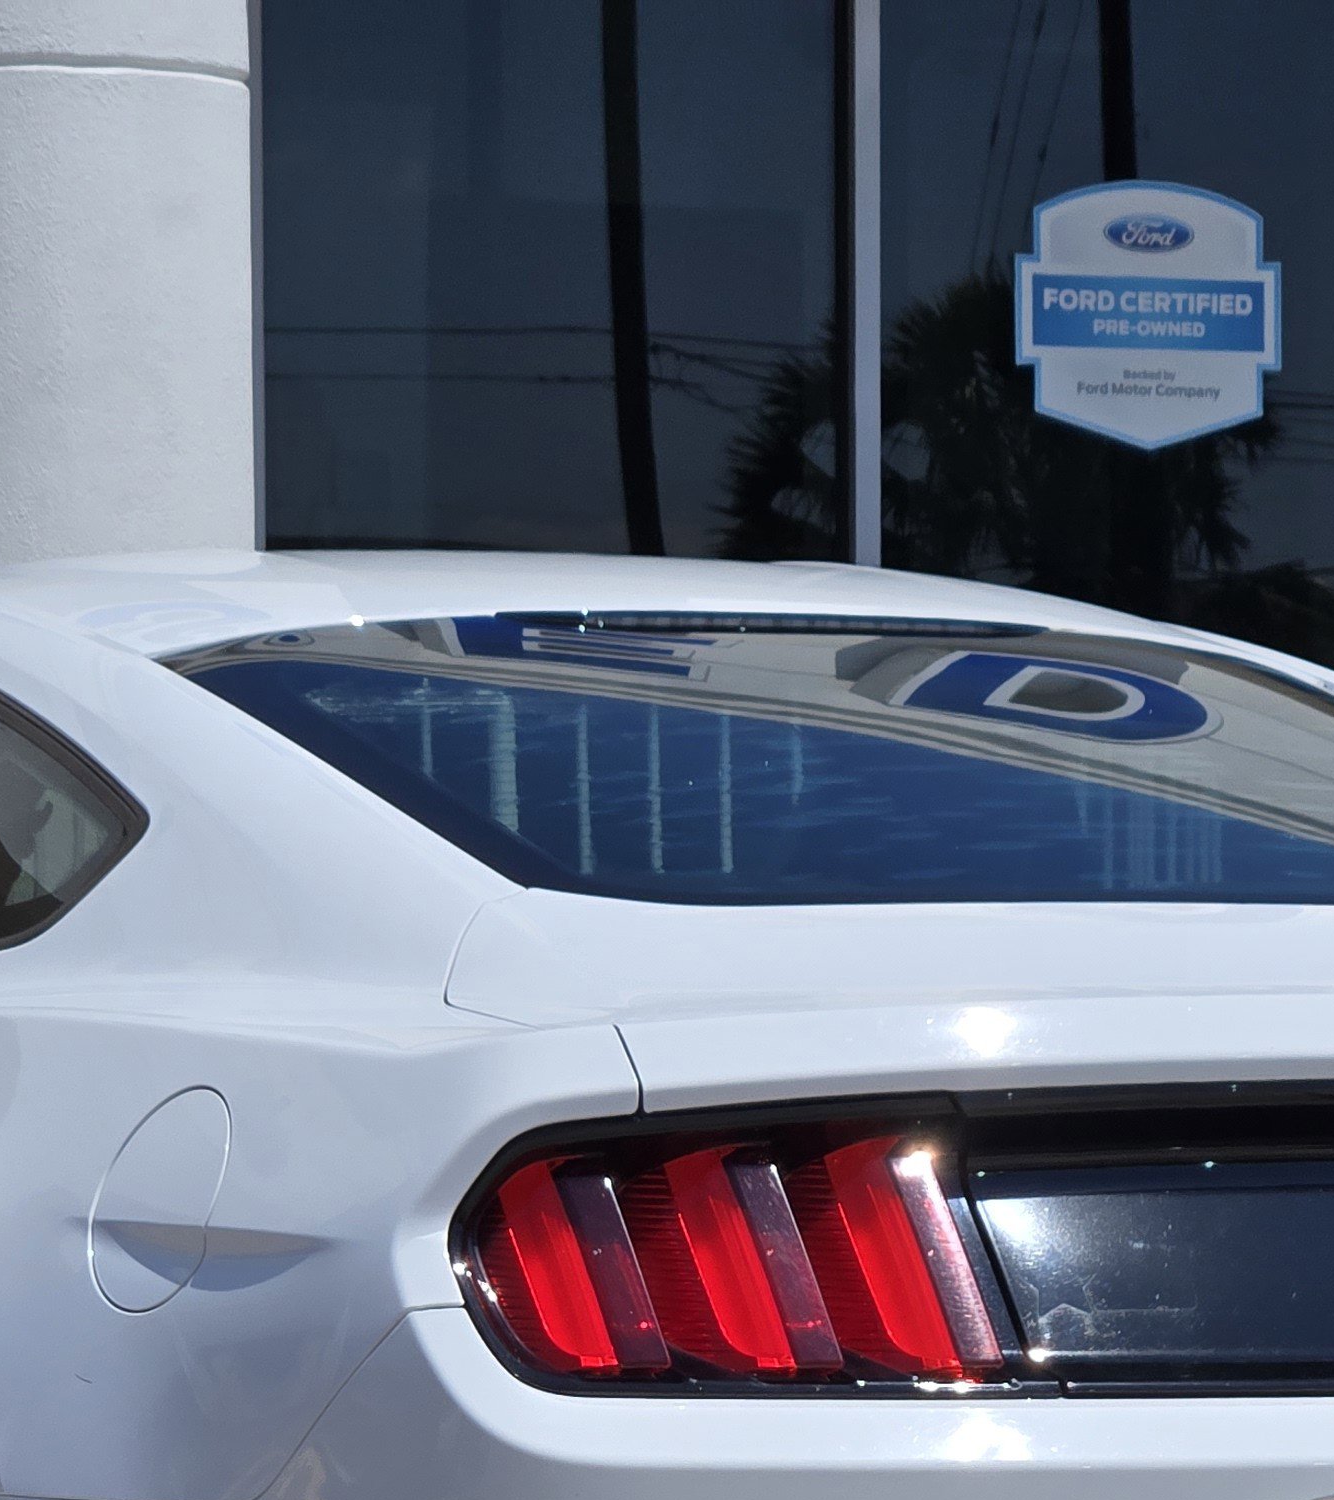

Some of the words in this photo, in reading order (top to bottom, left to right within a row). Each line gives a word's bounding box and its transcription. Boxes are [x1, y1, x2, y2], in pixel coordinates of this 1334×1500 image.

[1122, 221, 1176, 246] Ford
[1042, 287, 1115, 312] FORD
[1119, 290, 1254, 317] CERTIFIED
[1092, 318, 1207, 339] PRE-OWNED
[1163, 369, 1176, 383] by
[1077, 381, 1109, 396] Ford
[1111, 383, 1153, 397] Motor
[1155, 384, 1221, 402] Company
